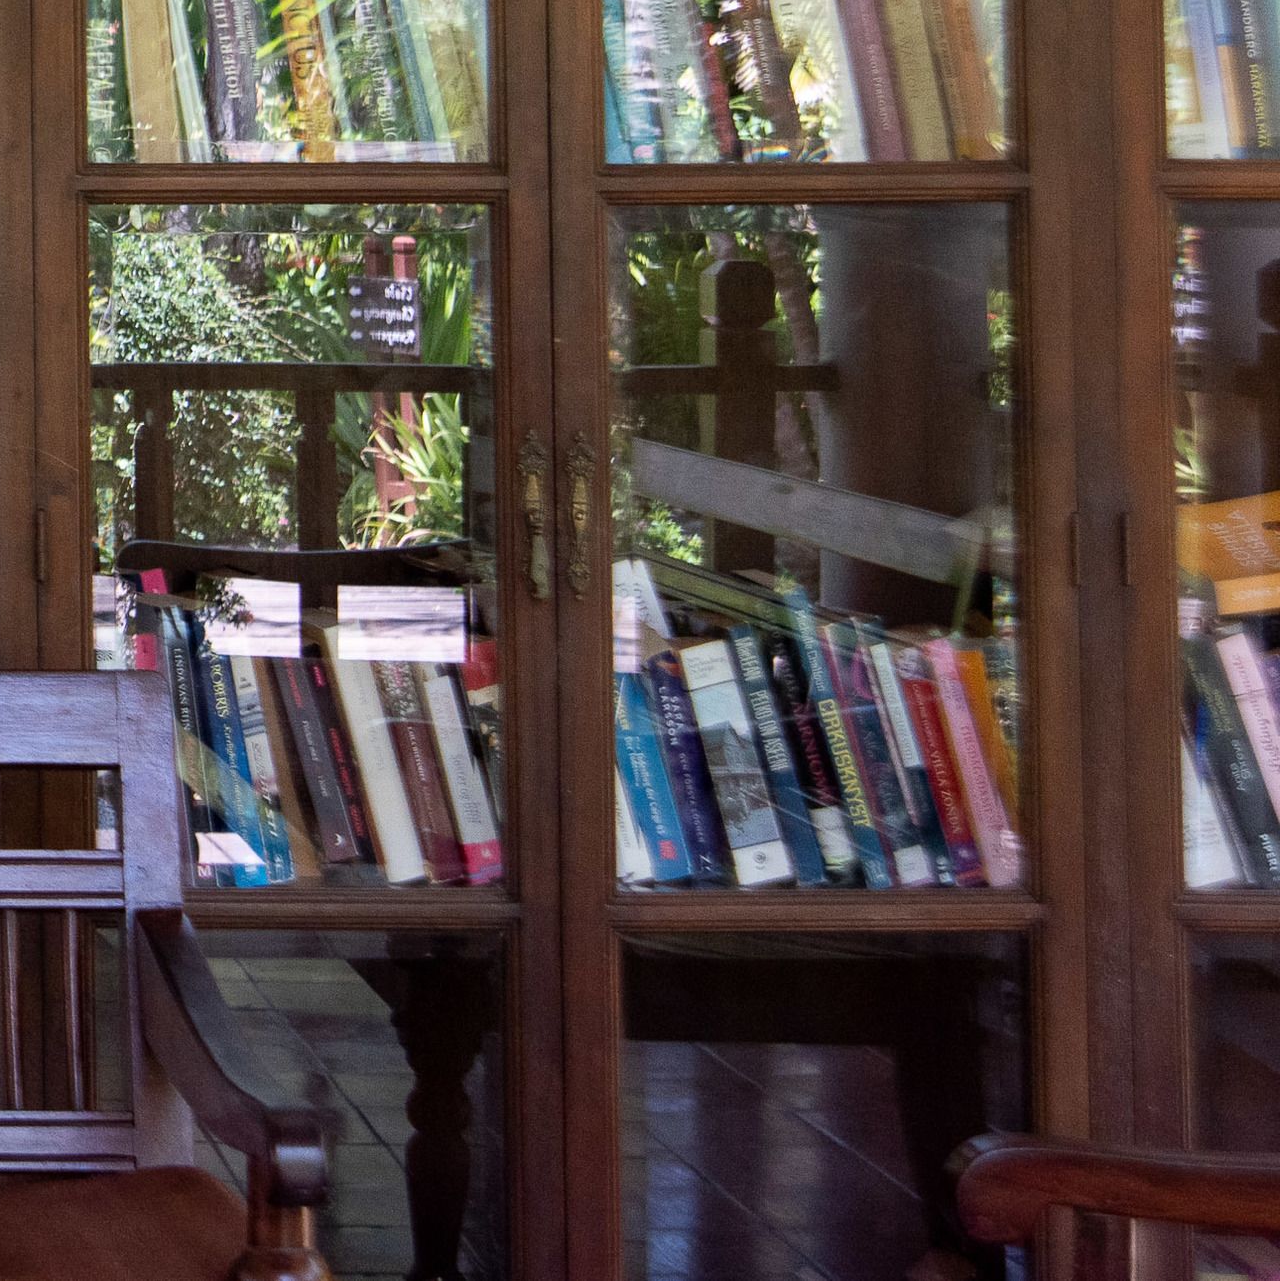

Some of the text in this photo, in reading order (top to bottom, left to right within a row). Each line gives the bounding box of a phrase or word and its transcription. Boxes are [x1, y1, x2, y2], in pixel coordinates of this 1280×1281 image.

[217, 32, 242, 99] ROBERT
[175, 647, 191, 704] LINDA VAN
[750, 690, 771, 719] PELKO
[660, 686, 679, 746] LARSSON
[671, 696, 685, 728] SARA
[820, 698, 873, 828] CIRKUSKNYST
[931, 750, 964, 835] VILLA ZONDA
